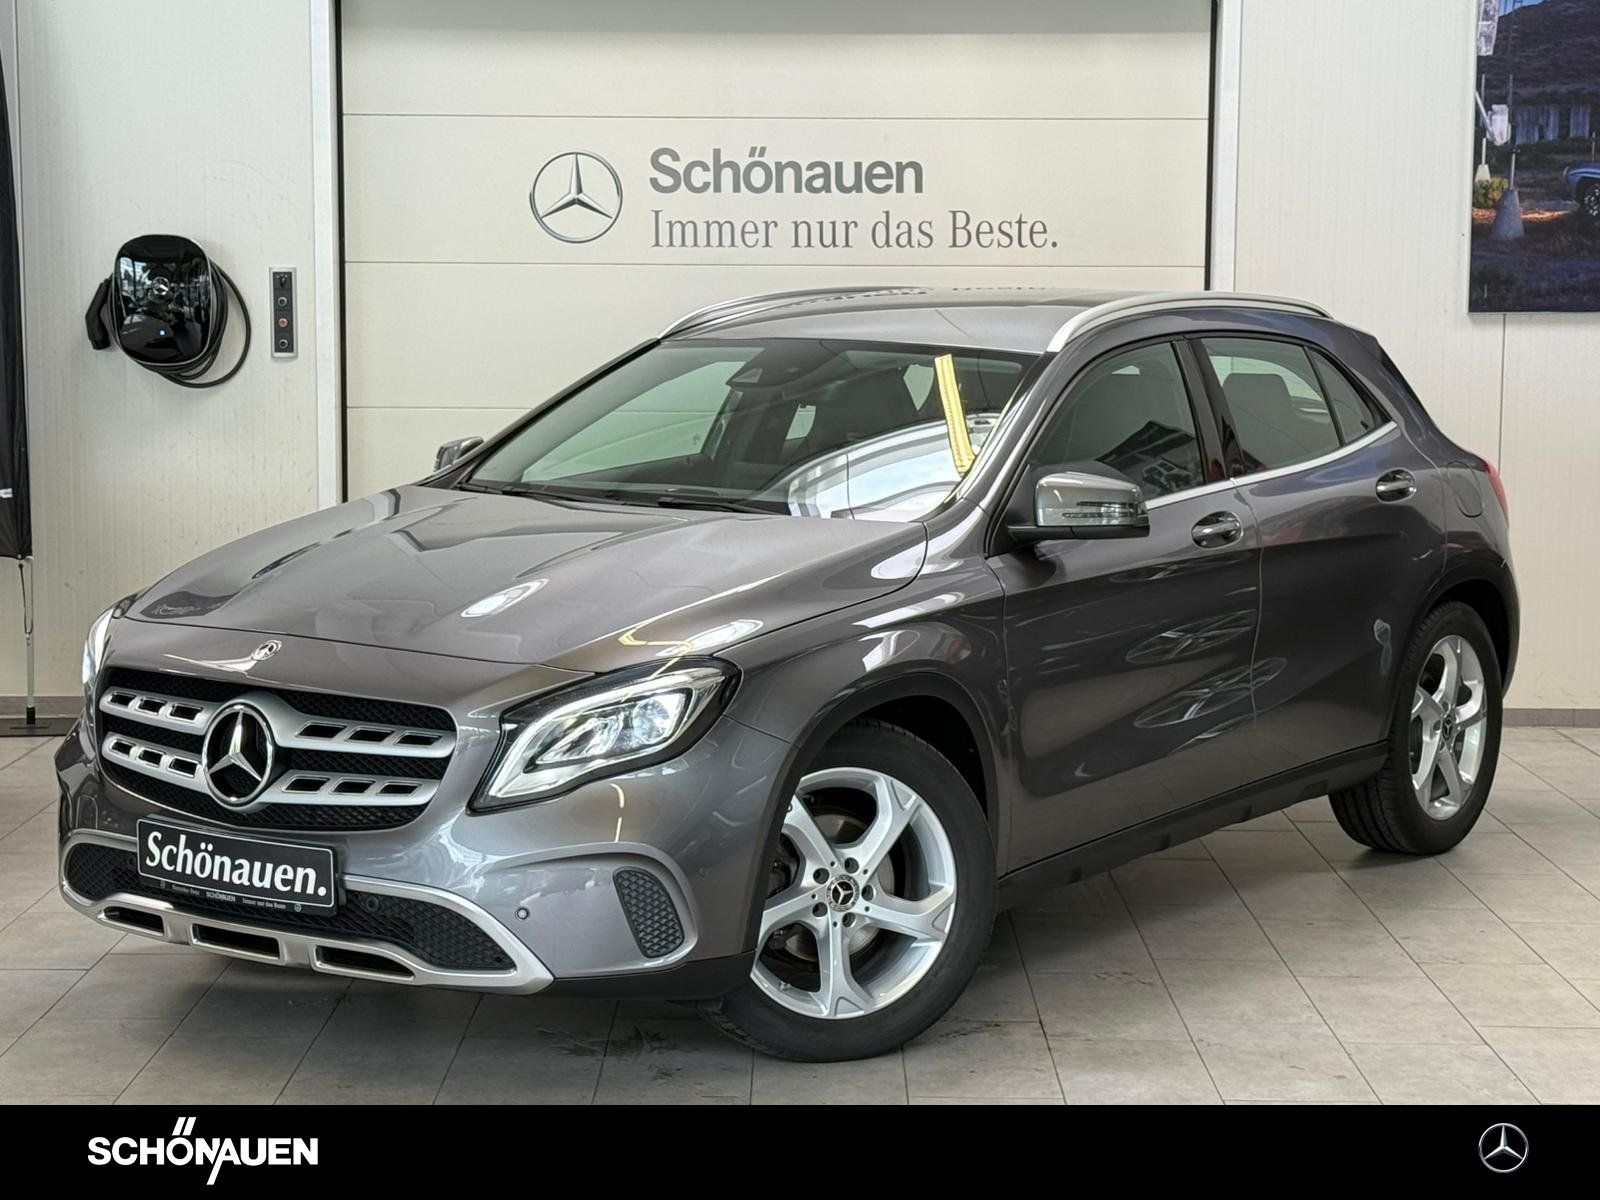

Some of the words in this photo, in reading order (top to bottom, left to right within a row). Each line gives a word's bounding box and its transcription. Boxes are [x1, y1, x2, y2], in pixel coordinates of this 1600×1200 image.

[649, 146, 924, 195] Schönauen
[651, 209, 779, 249] Immer
[791, 220, 859, 249] nur
[871, 210, 934, 249] das
[948, 210, 1058, 249] Beste.
[145, 831, 327, 896] Schönauen.
